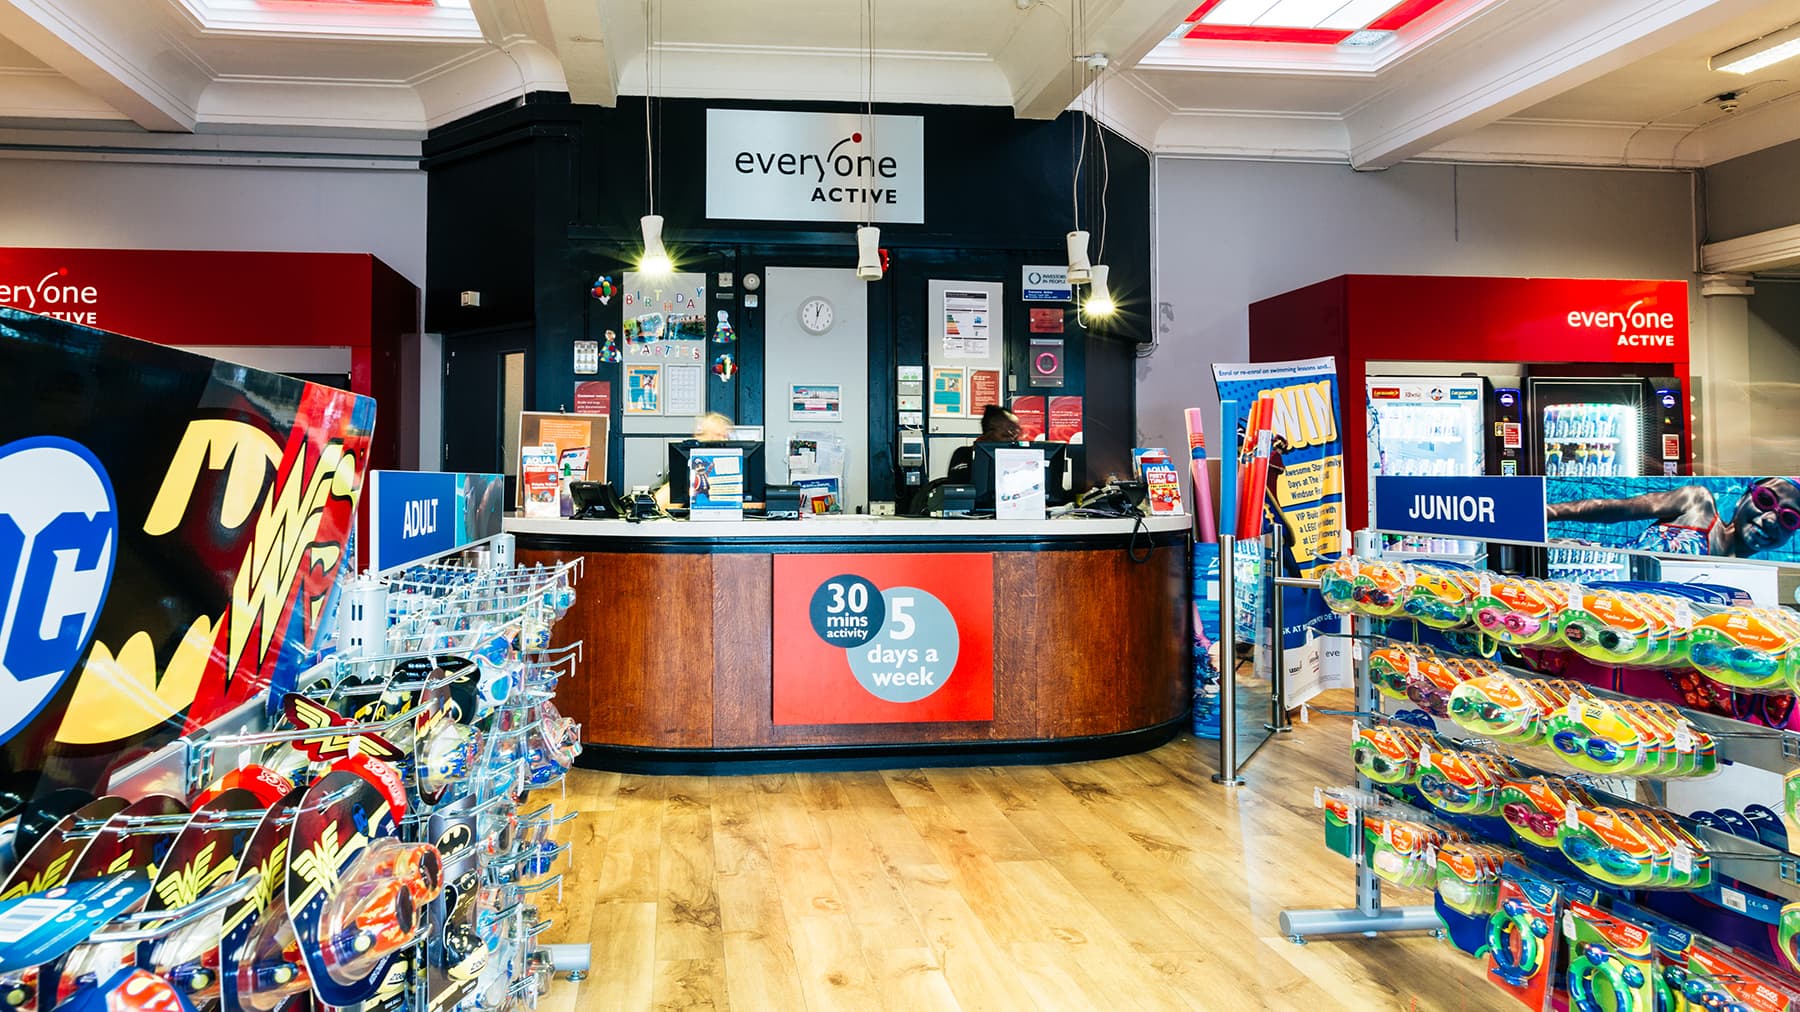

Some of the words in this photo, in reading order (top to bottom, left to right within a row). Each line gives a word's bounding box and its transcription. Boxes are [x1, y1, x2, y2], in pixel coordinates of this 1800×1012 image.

[735, 138, 897, 183] everyone
[811, 187, 897, 204] ACTIVE
[0, 272, 97, 308] eryone
[626, 287, 703, 312] BIRTHDAY
[40, 311, 97, 325] TIVE
[1568, 300, 1674, 333] everyone
[1617, 335, 1675, 346] ACTIVE
[1260, 382, 1333, 443] WIN
[1285, 466, 1311, 477] Awesome
[1287, 479, 1301, 489] Days
[1291, 488, 1314, 499] Windsor
[403, 498, 438, 540] ADULT
[1408, 494, 1495, 523] JUNIOR
[826, 583, 869, 614] 30
[826, 613, 869, 628] mins
[889, 597, 916, 641] 5
[826, 629, 869, 640] activity
[867, 644, 918, 668] days
[925, 648, 939, 663] a
[872, 667, 934, 687] week
